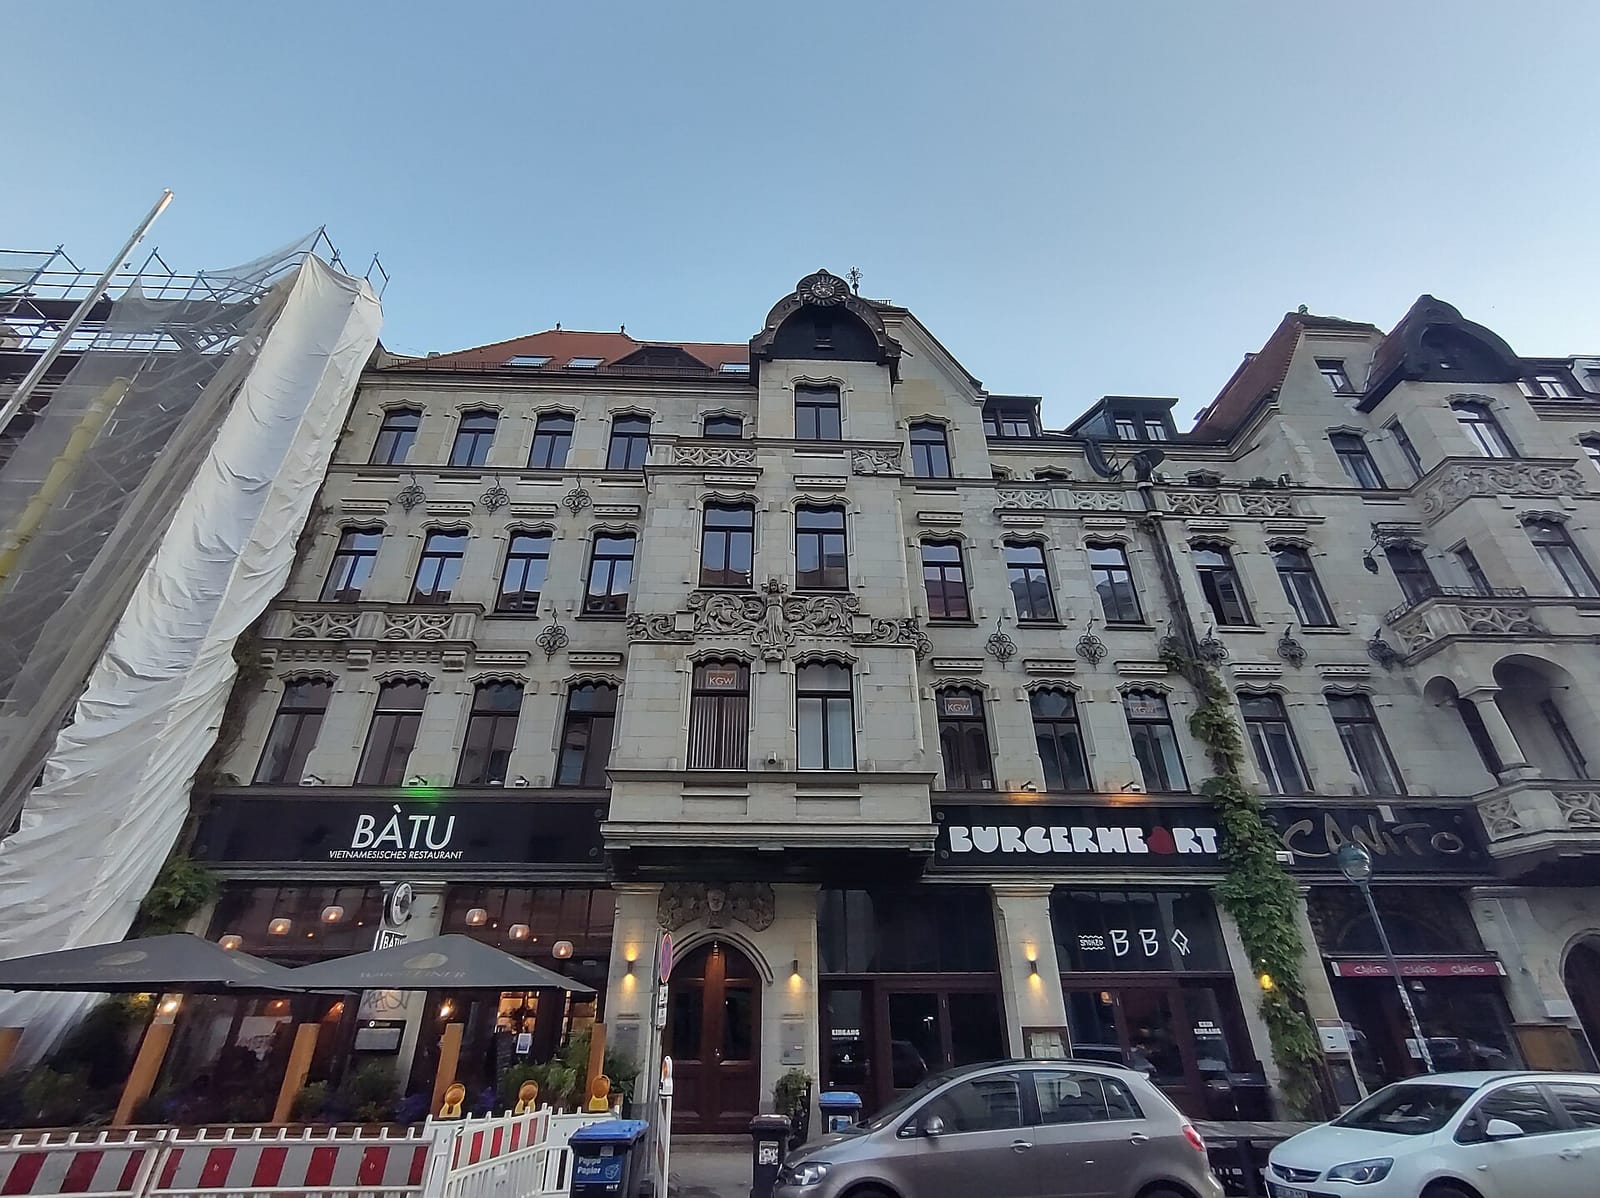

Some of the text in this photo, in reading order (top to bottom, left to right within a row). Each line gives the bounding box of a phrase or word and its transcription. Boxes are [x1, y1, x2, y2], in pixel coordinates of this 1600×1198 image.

[709, 677, 734, 686] KGW
[947, 703, 971, 712] KGW
[351, 803, 456, 850] BÀTU
[329, 850, 464, 860] VIETNAMESISCHES RESTAURANT
